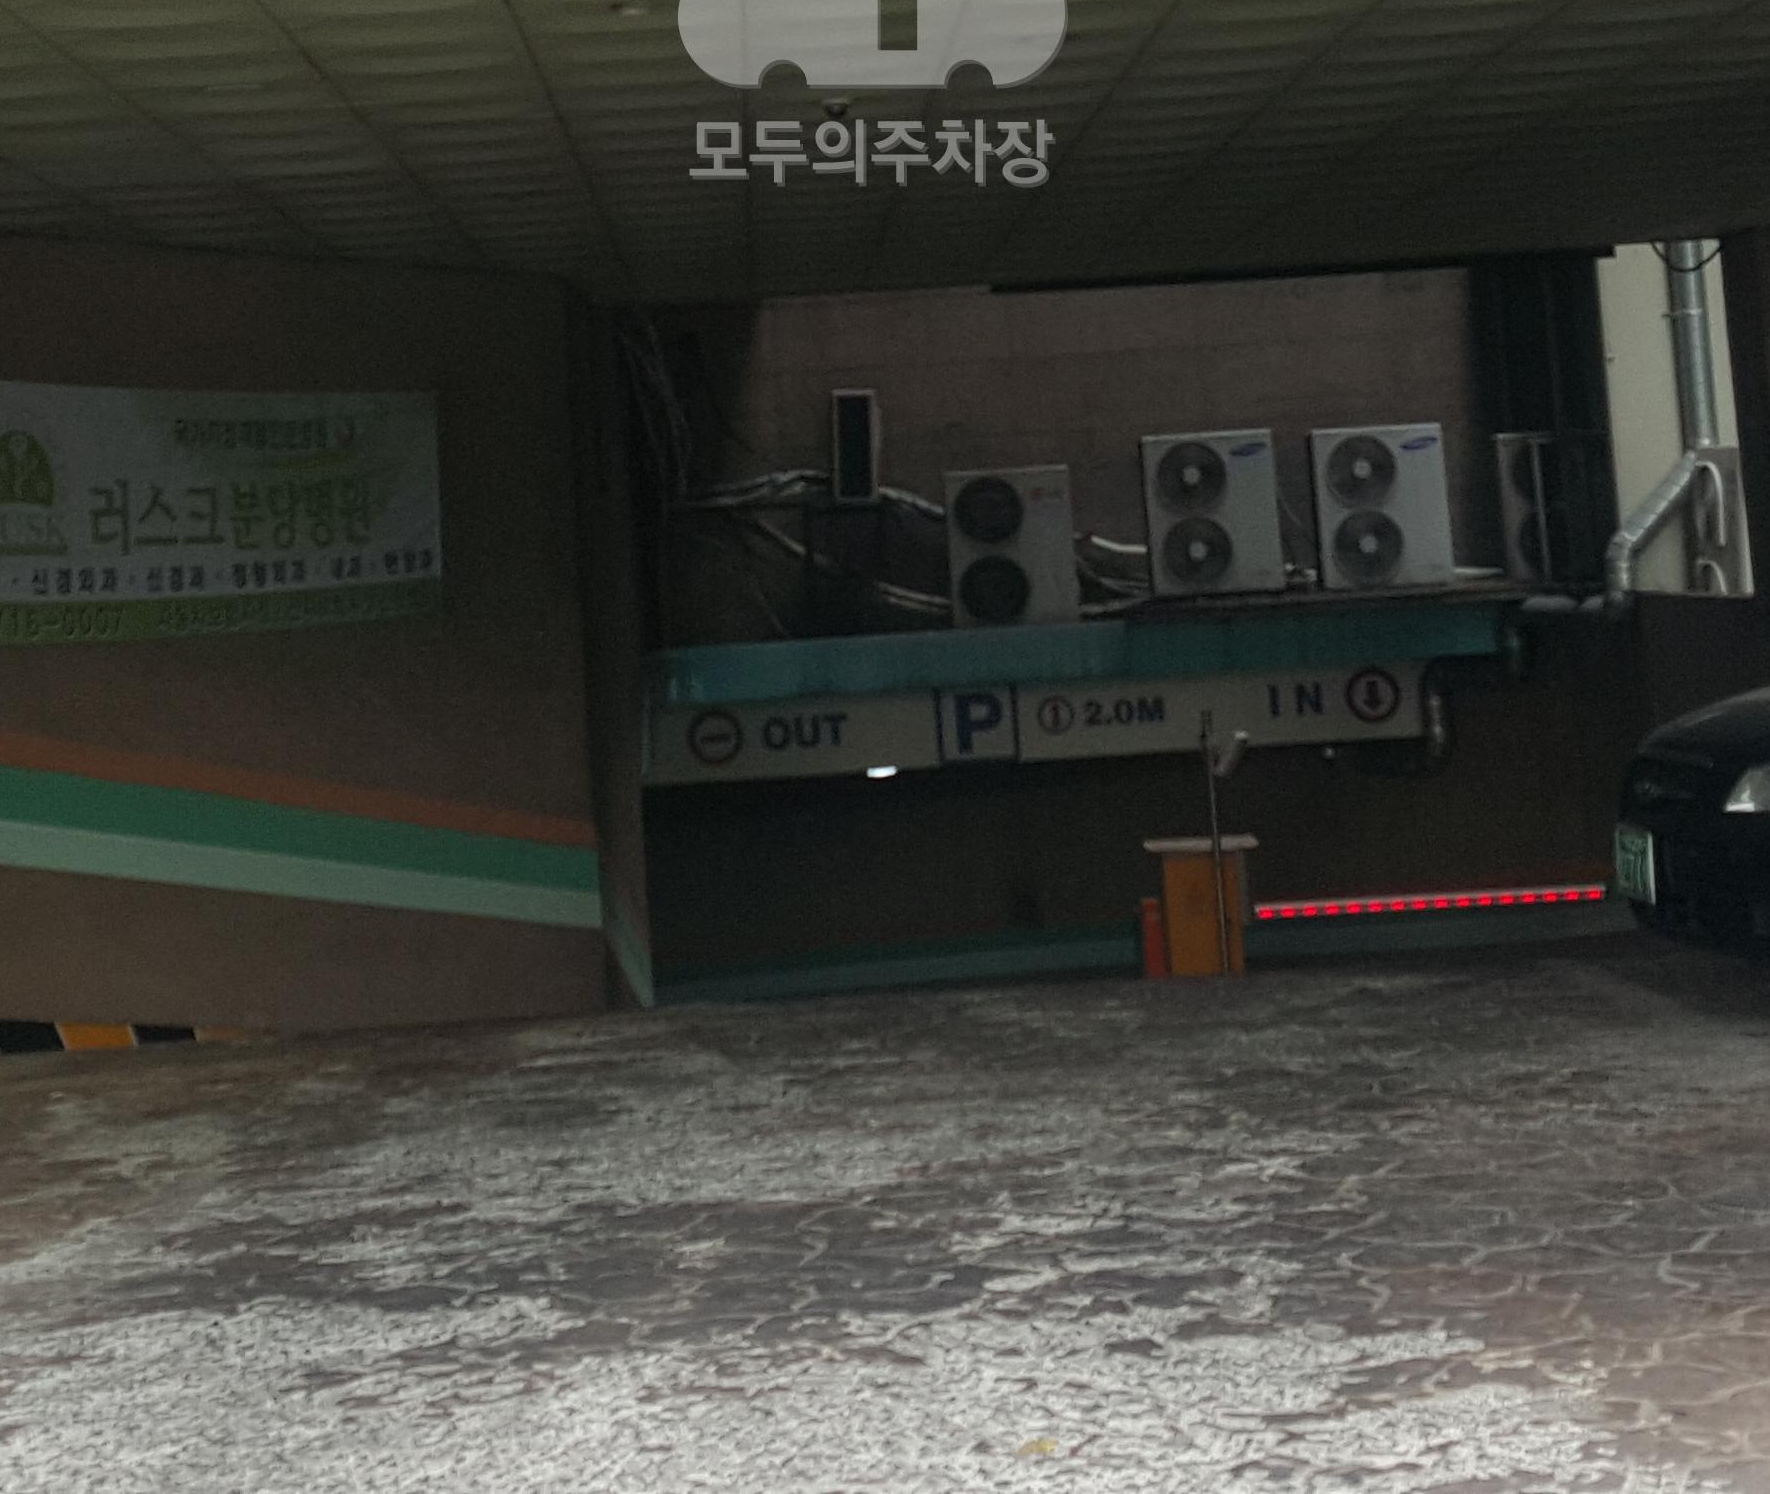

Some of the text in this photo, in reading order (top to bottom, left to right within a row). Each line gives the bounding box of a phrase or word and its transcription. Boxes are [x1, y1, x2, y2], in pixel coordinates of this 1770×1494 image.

[761, 683, 1324, 754] OUT P 2.0M IN
